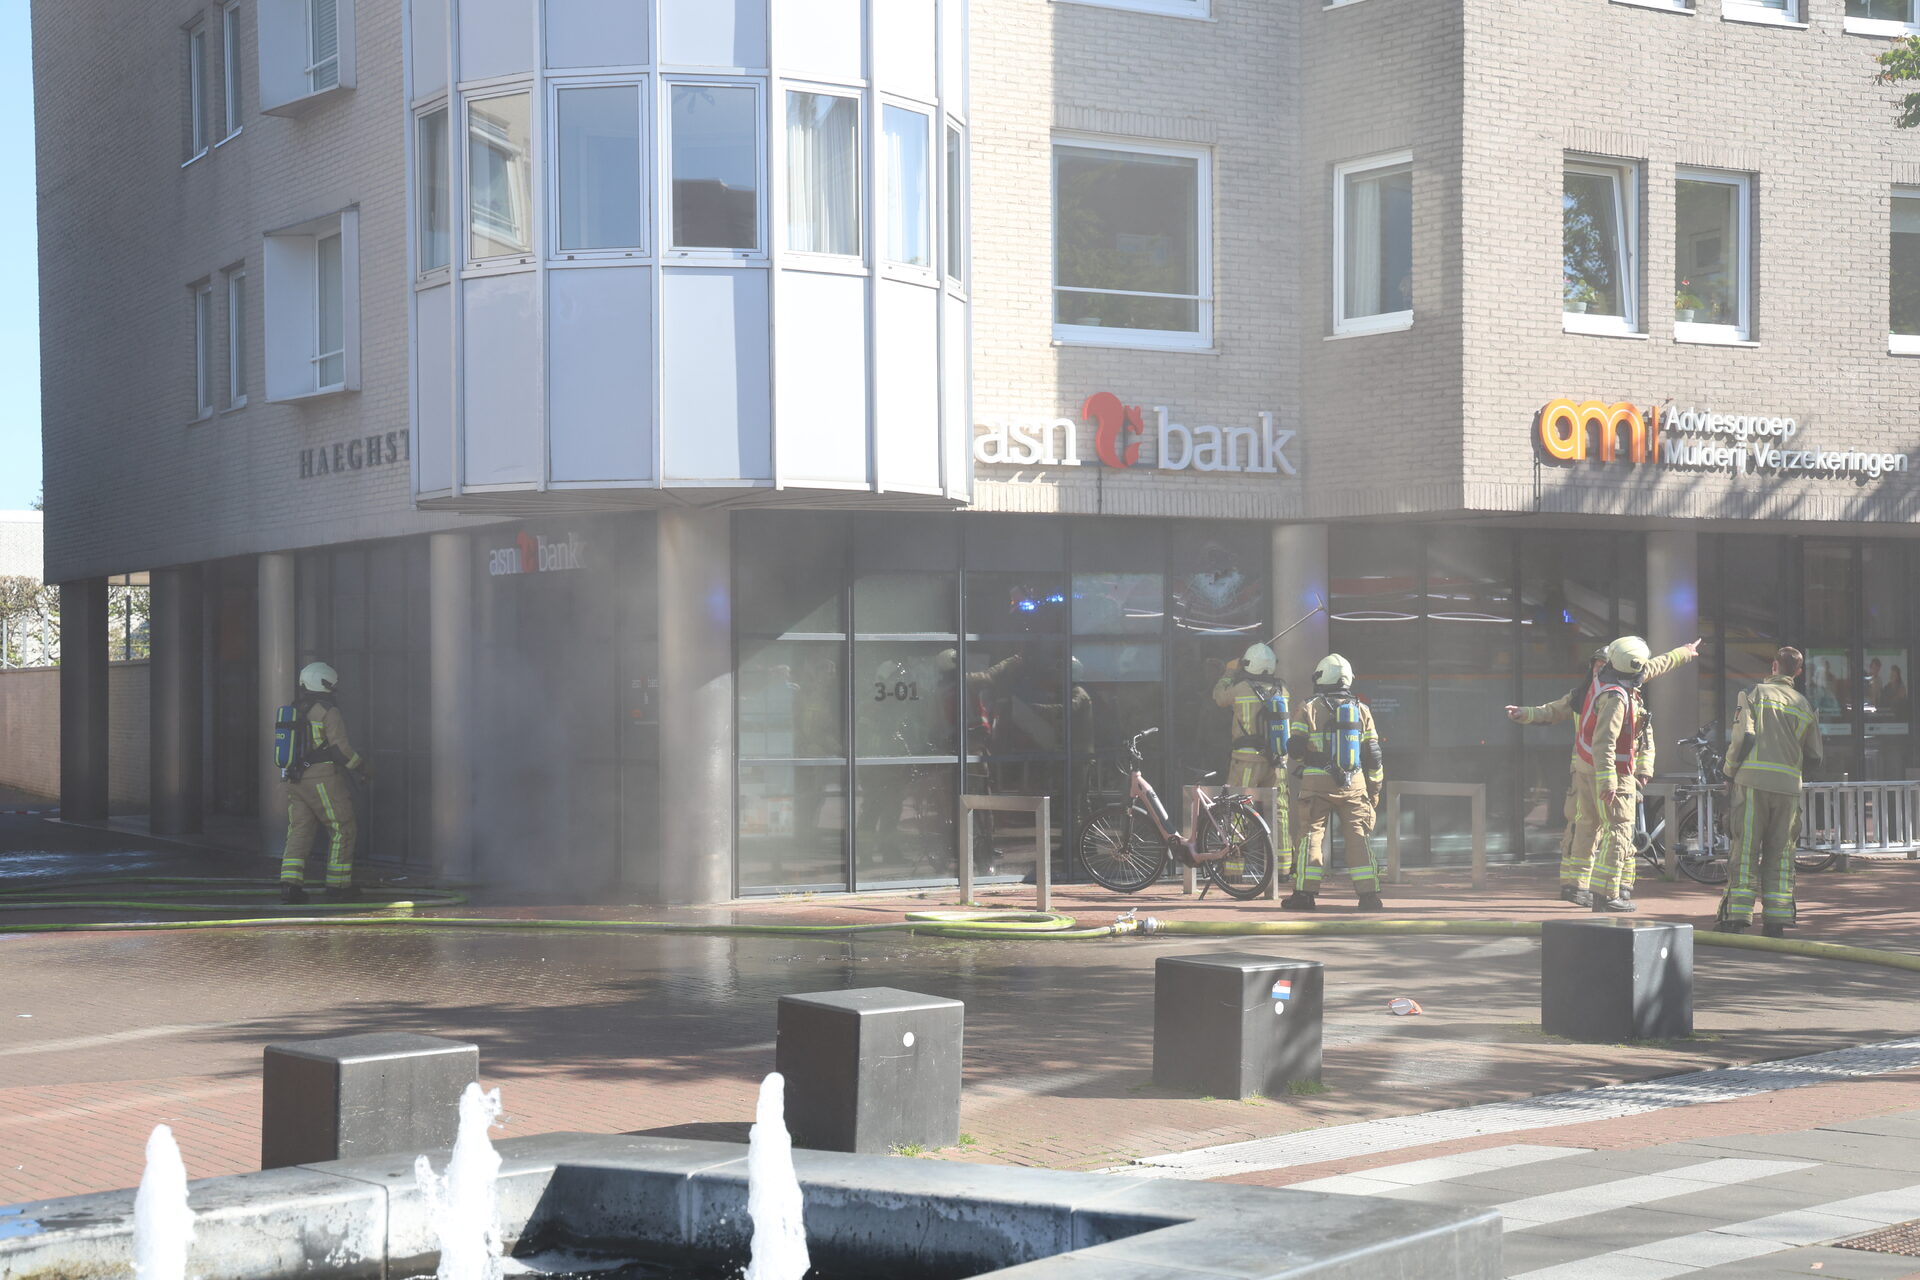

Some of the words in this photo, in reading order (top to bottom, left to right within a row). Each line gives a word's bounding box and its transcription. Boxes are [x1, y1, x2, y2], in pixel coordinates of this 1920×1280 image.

[973, 416, 1081, 466] asn
[1153, 405, 1297, 475] bank
[1664, 404, 1797, 442] Adviesgroep
[1663, 438, 1748, 473] Mulderij
[1754, 441, 1908, 478] Verzekeringen
[489, 547, 520, 576] asn
[536, 532, 583, 572] bank
[874, 681, 919, 701] 3-01
